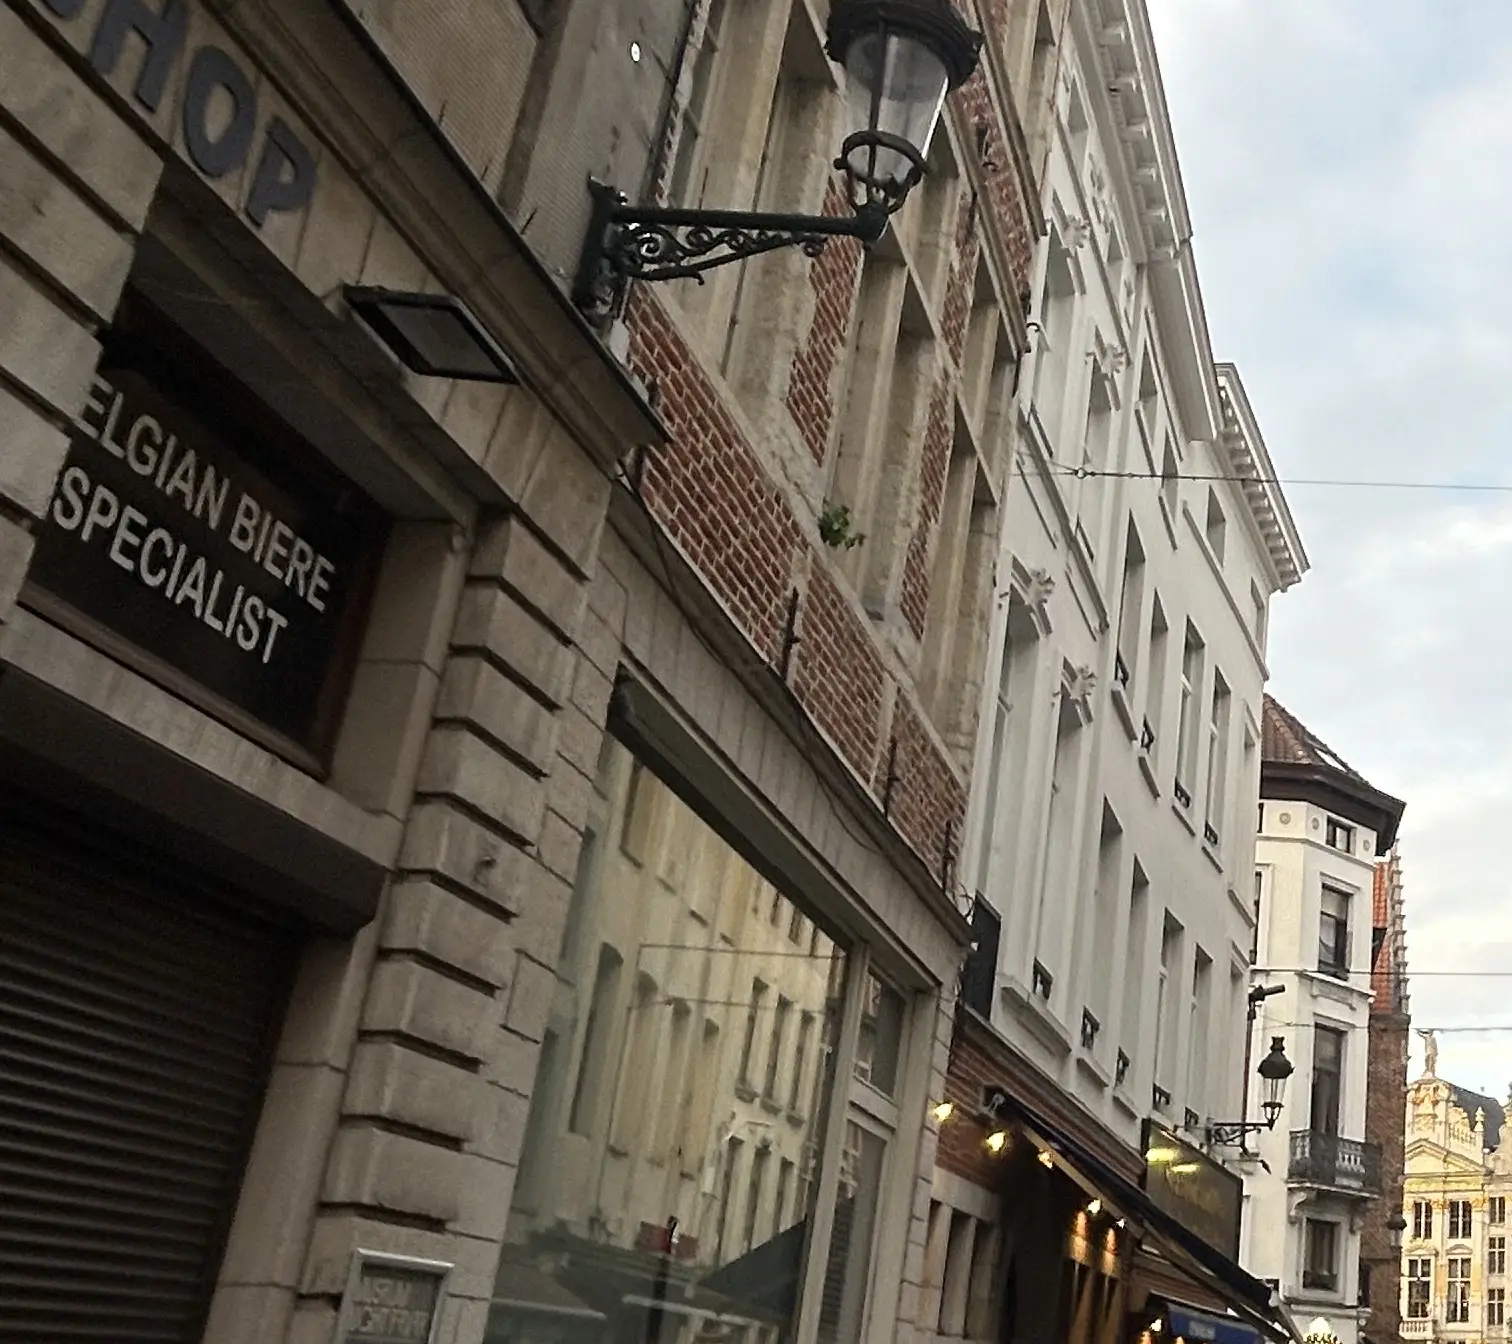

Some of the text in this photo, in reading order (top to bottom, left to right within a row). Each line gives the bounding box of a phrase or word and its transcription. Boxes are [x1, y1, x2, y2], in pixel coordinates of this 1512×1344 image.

[52, 466, 288, 664] SPECIALIST
[70, 375, 336, 613] ELGIAN BIERE
